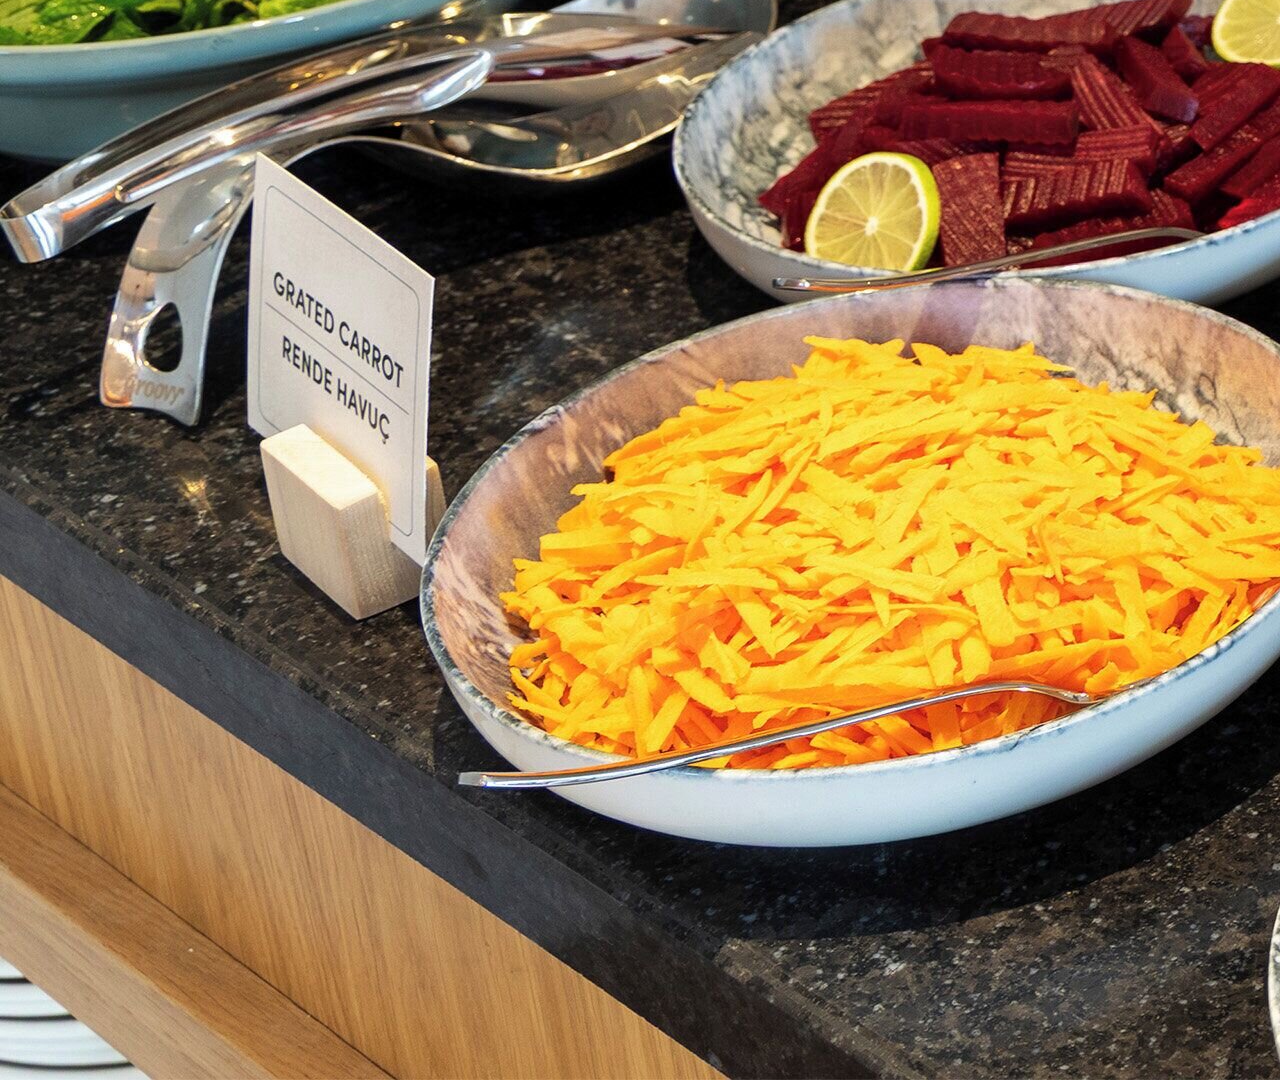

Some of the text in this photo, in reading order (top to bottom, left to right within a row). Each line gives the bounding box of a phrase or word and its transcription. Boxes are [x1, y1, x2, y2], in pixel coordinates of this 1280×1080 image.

[273, 271, 404, 389] GRATED CARROT
[282, 336, 391, 444] RENDE HAVUÇ
